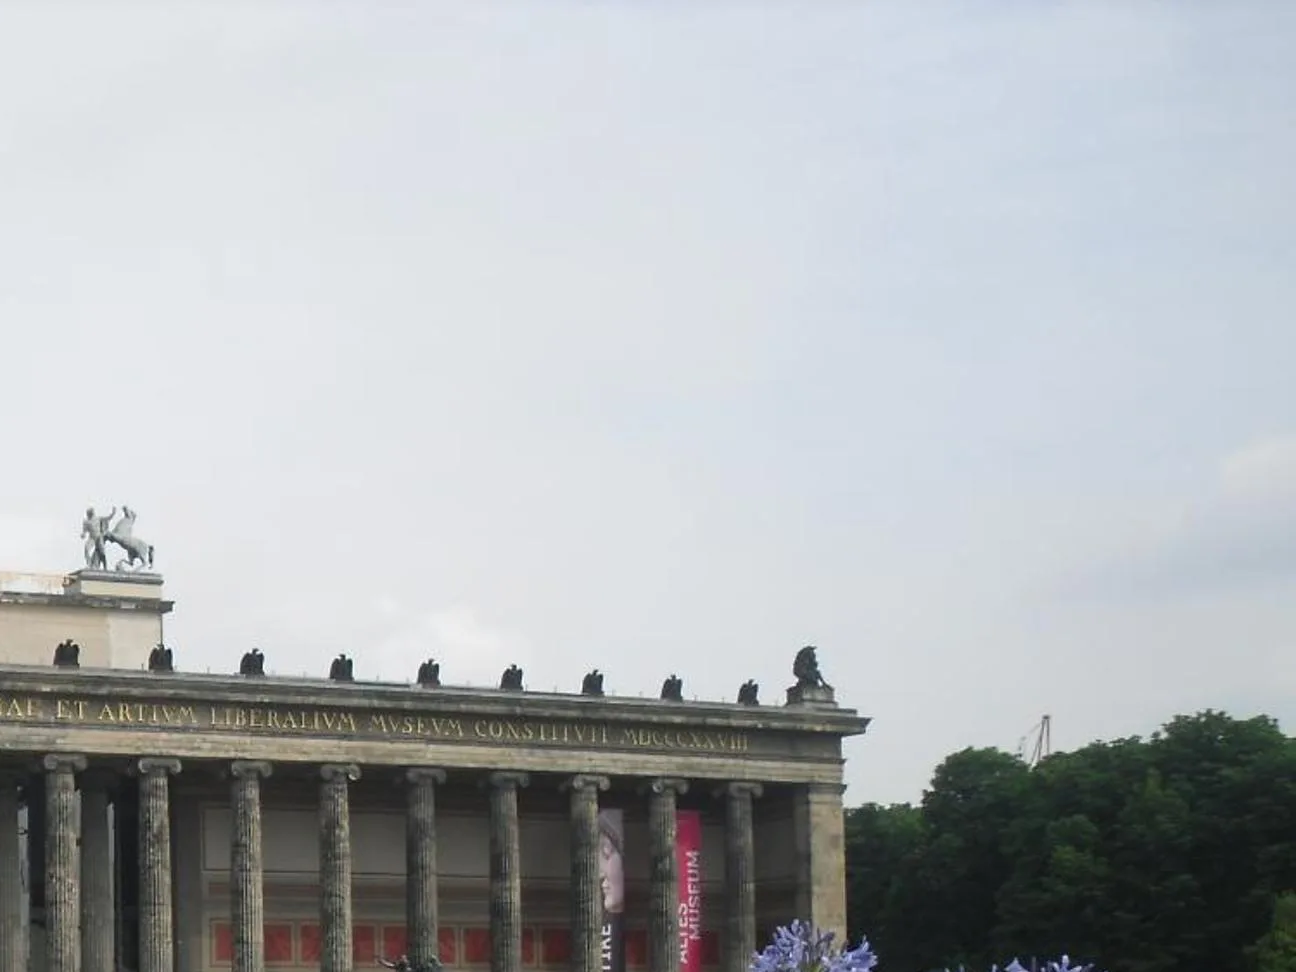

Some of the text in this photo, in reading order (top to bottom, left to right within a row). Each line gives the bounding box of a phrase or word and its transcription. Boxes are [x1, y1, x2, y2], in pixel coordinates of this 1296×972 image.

[56, 700, 89, 720] ET
[98, 702, 197, 724] ARTIVM
[210, 706, 357, 732] LIBERALIVM
[368, 714, 464, 738] MVSEVM
[475, 719, 608, 744] CONSTITVIT
[619, 727, 748, 750] MDCCCXXVIII
[686, 851, 700, 940] MUSEUM
